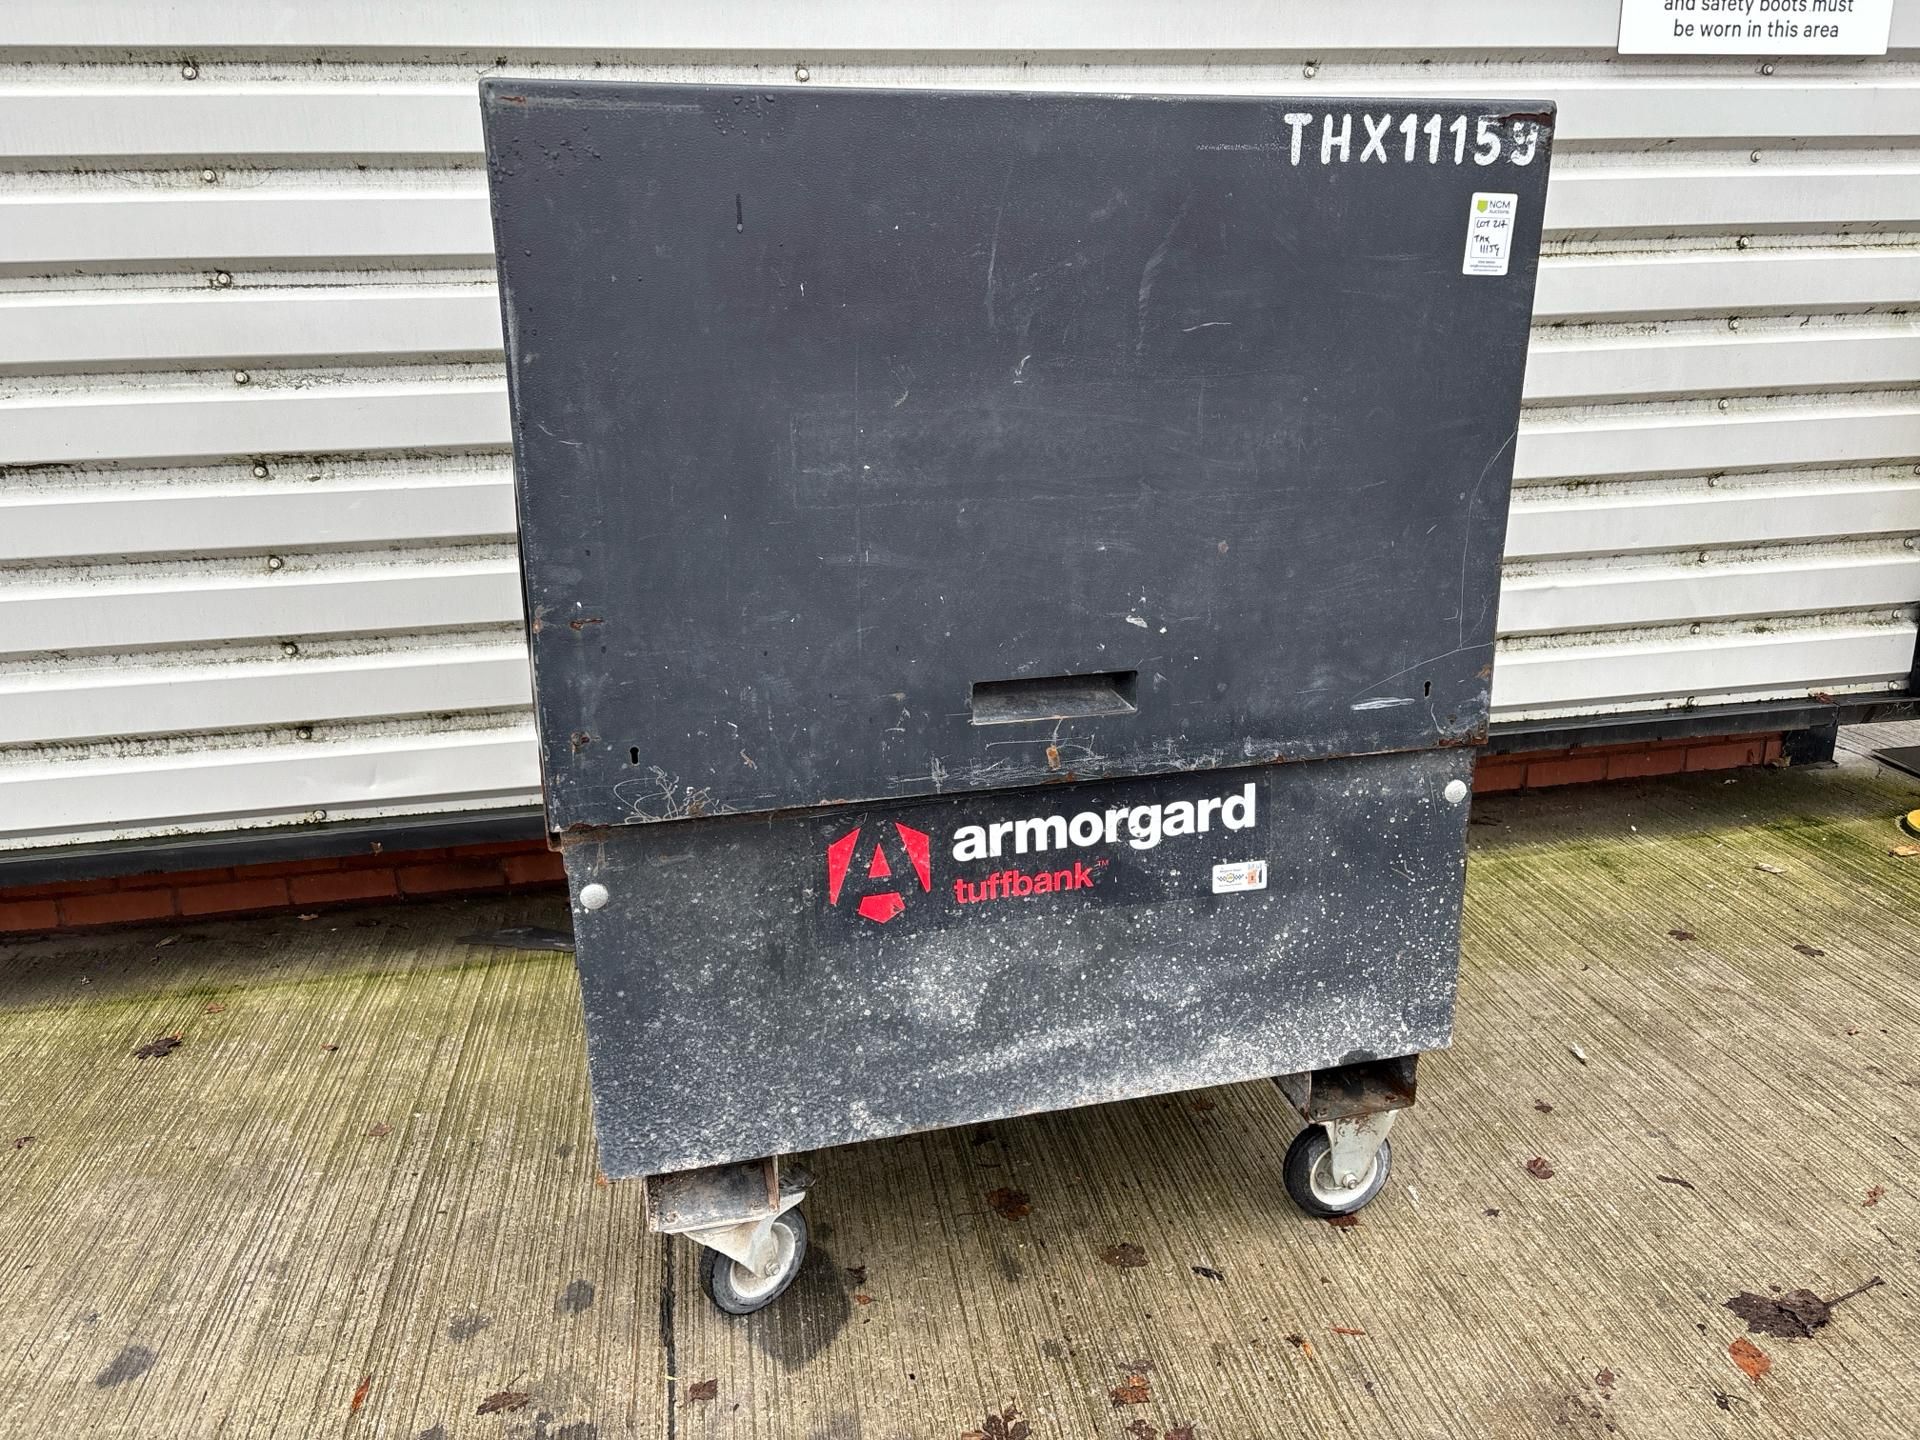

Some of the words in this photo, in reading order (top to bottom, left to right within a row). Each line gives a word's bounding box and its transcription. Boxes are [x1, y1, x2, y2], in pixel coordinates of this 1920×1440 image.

[1664, 0, 1695, 11] and
[1701, 0, 1753, 16] safety
[1760, 0, 1806, 12] boots
[1812, 0, 1853, 12] must
[1673, 18, 1694, 37] be
[1700, 24, 1741, 37] worn
[1747, 20, 1761, 37] in
[1768, 19, 1798, 38] this
[1803, 24, 1839, 38] area
[1488, 200, 1510, 209] NCM
[952, 783, 1256, 862] armorgard
